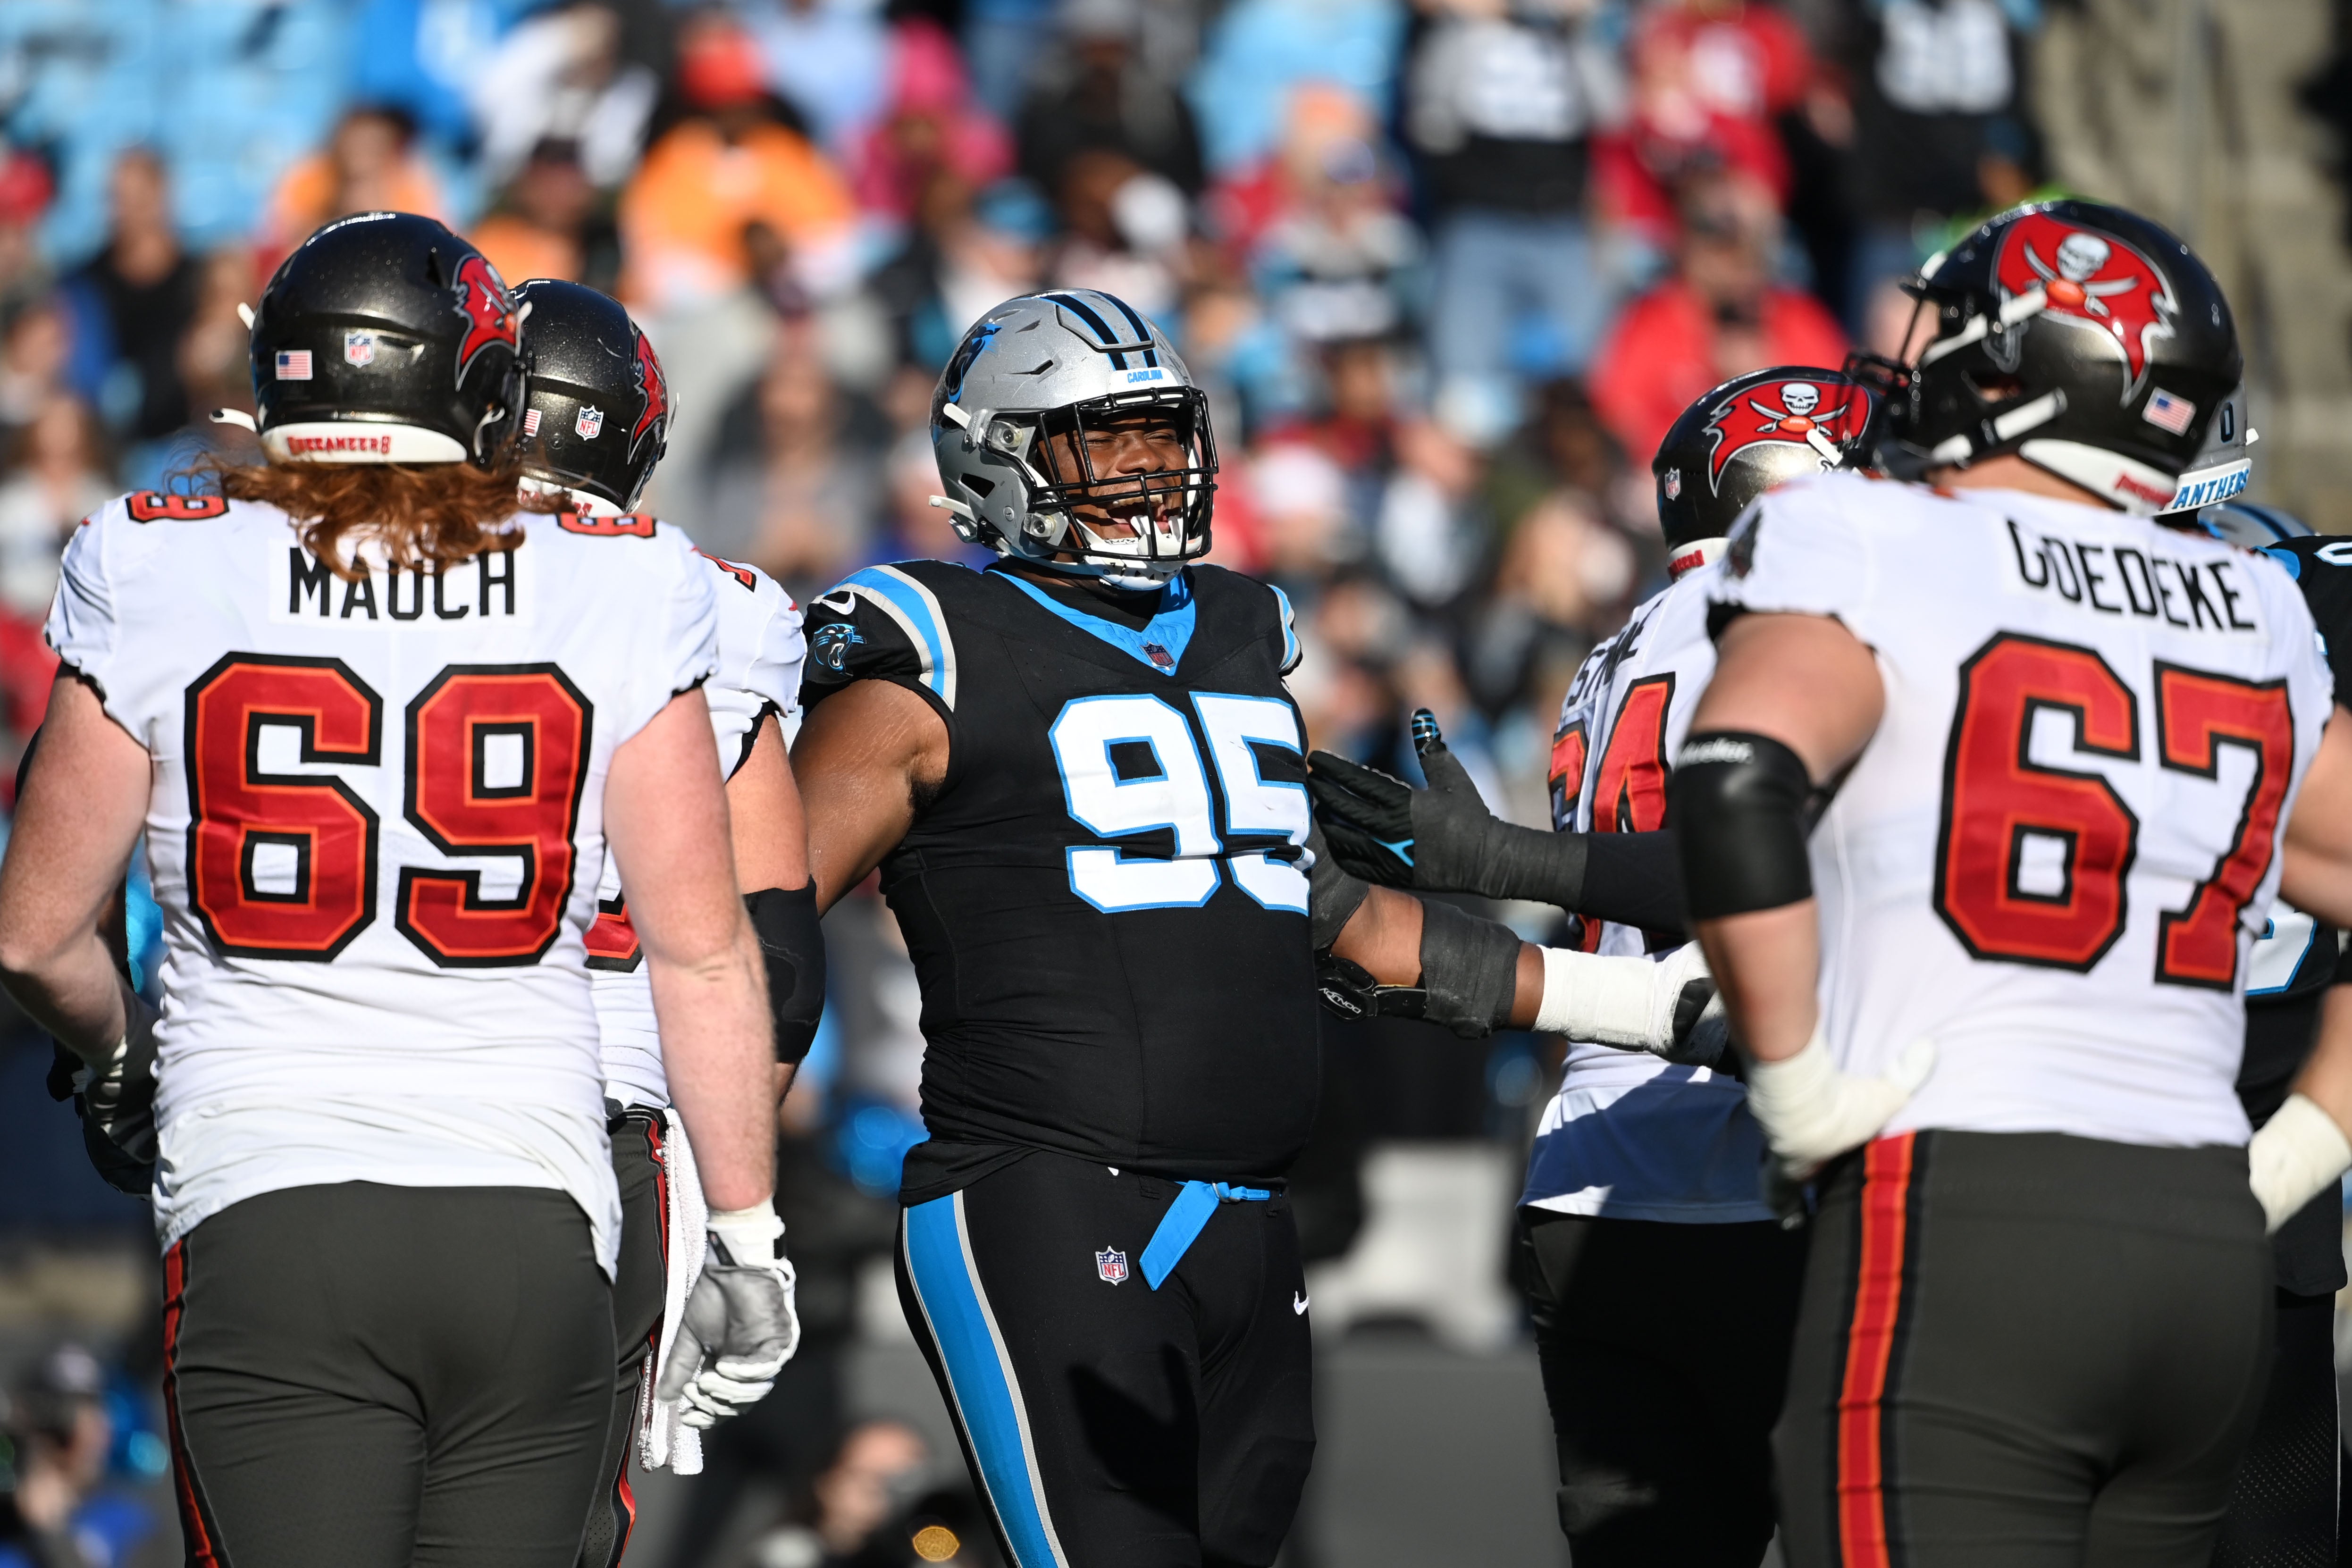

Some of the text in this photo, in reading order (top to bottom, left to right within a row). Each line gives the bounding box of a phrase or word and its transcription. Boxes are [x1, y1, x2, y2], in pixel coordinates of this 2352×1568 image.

[1127, 369, 1163, 383] CAROLINA
[580, 419, 596, 434] NFL
[2158, 468, 2250, 511] ANTHERS
[289, 546, 515, 621] MAUCH
[2007, 517, 2257, 632] GOEDEKE
[1150, 653, 1173, 664] NFL
[184, 651, 594, 968] 69
[1048, 691, 1316, 917] 95
[1931, 629, 2295, 995] 67
[1318, 987, 1361, 1015] DONJOY
[1103, 1264, 1125, 1278] NFL
